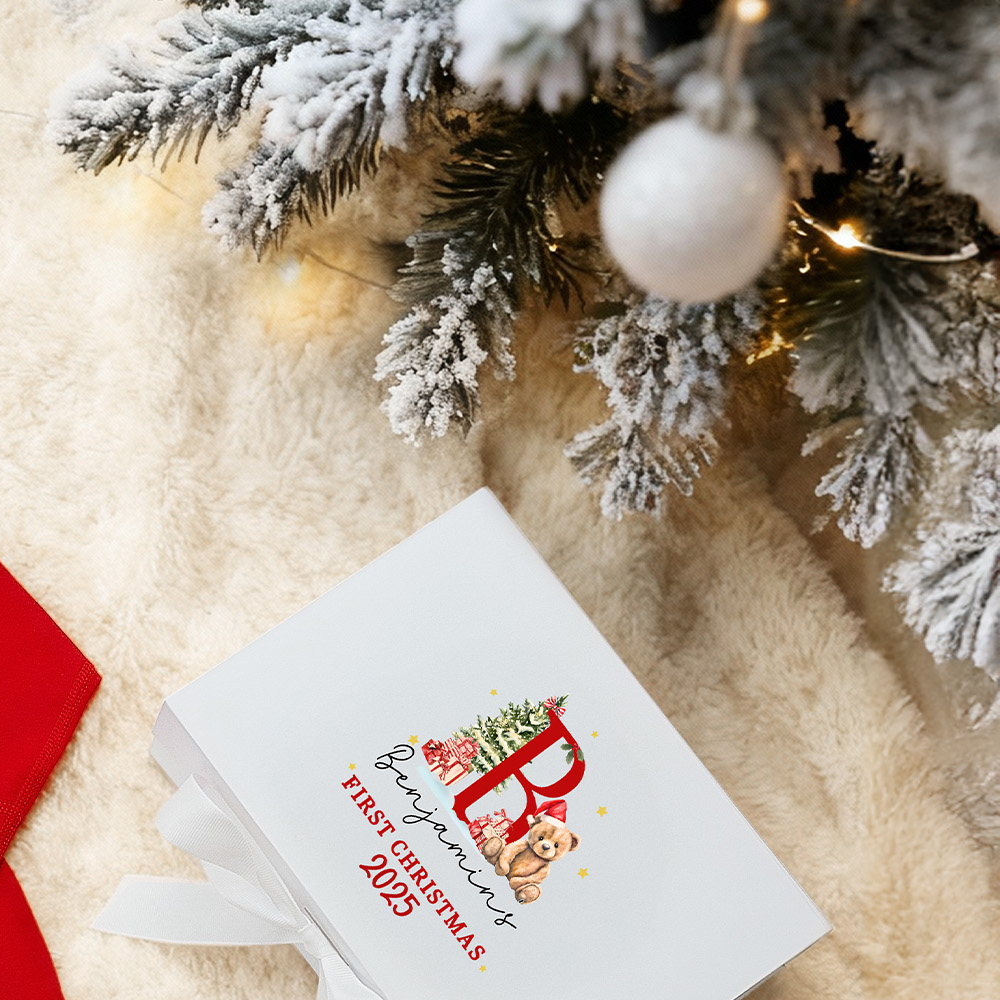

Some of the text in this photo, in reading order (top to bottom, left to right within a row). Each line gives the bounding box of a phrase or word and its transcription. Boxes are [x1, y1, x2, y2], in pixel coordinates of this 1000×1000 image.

[341, 774, 486, 961] FIRST CHRISTMAS
[359, 854, 420, 917] 2025
